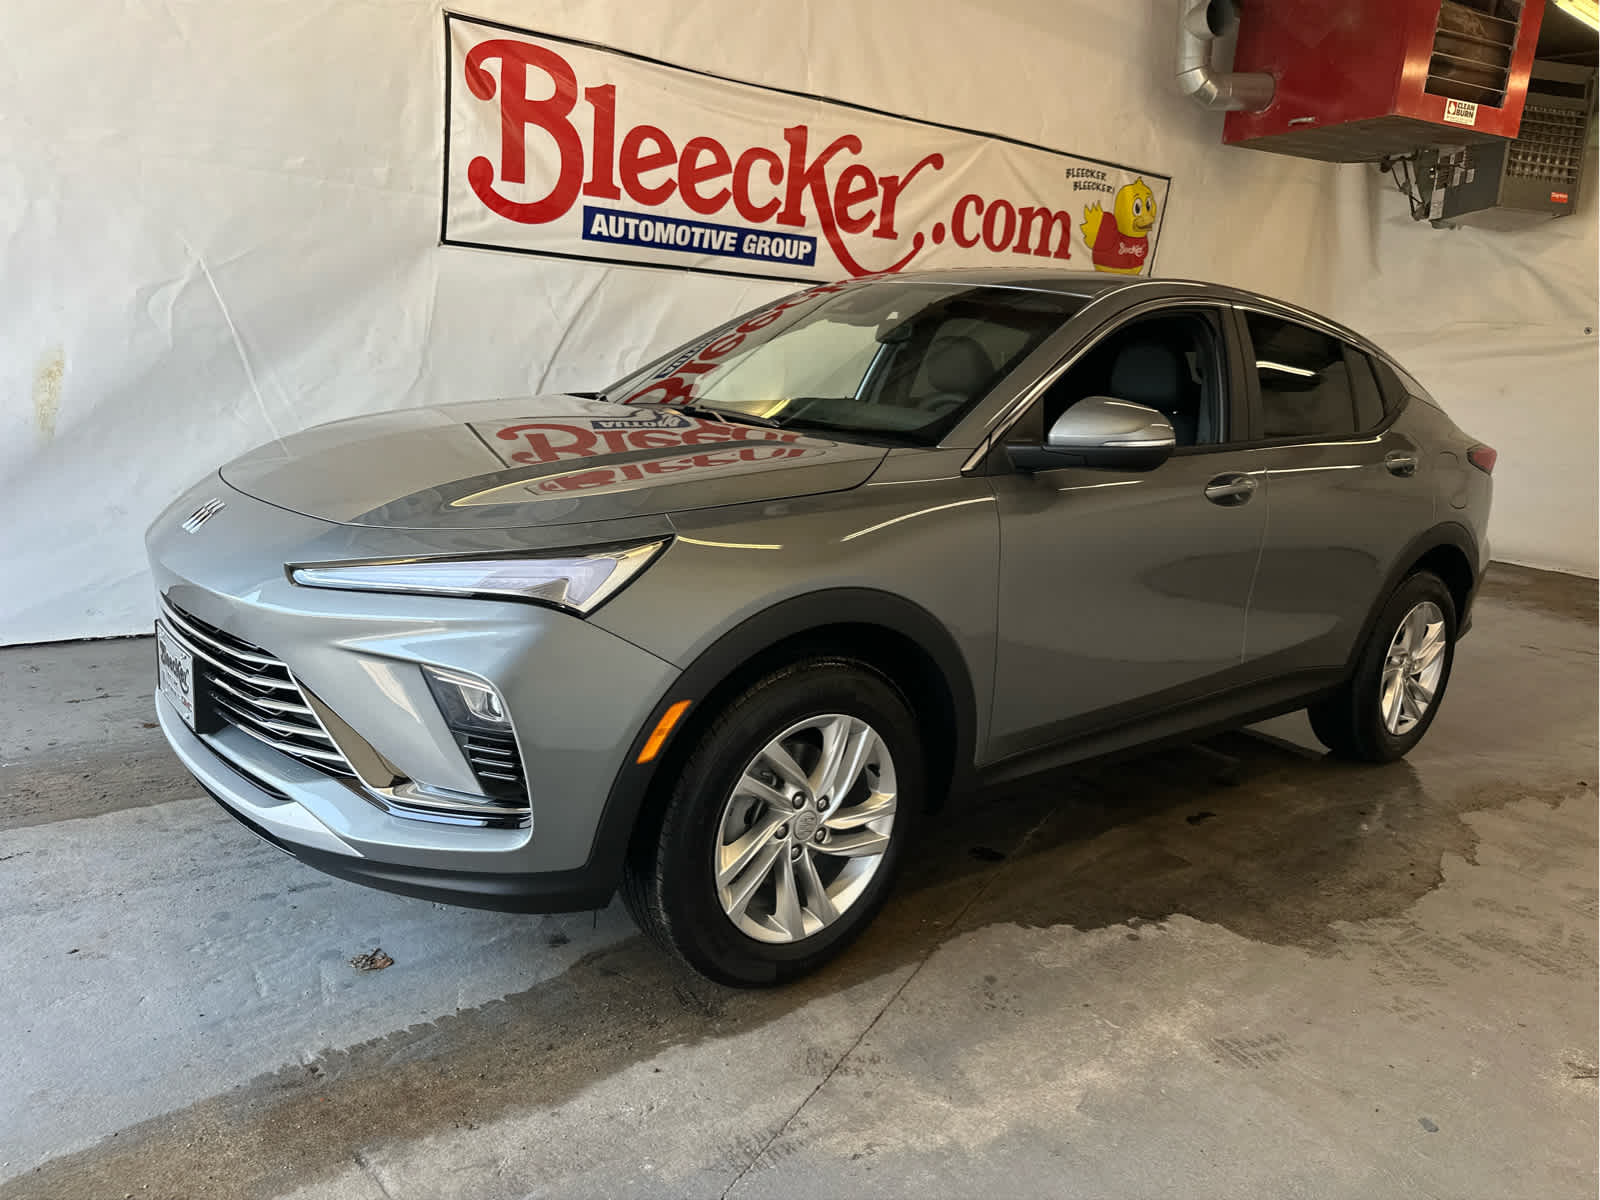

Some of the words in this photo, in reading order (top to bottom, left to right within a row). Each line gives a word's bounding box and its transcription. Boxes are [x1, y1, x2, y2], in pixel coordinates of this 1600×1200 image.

[1457, 102, 1476, 111] CLEAN
[1456, 109, 1474, 118] BURN
[1066, 168, 1107, 181] BLEECKER
[590, 214, 737, 252] AUTOMOTIVE
[742, 235, 812, 260] GROUP
